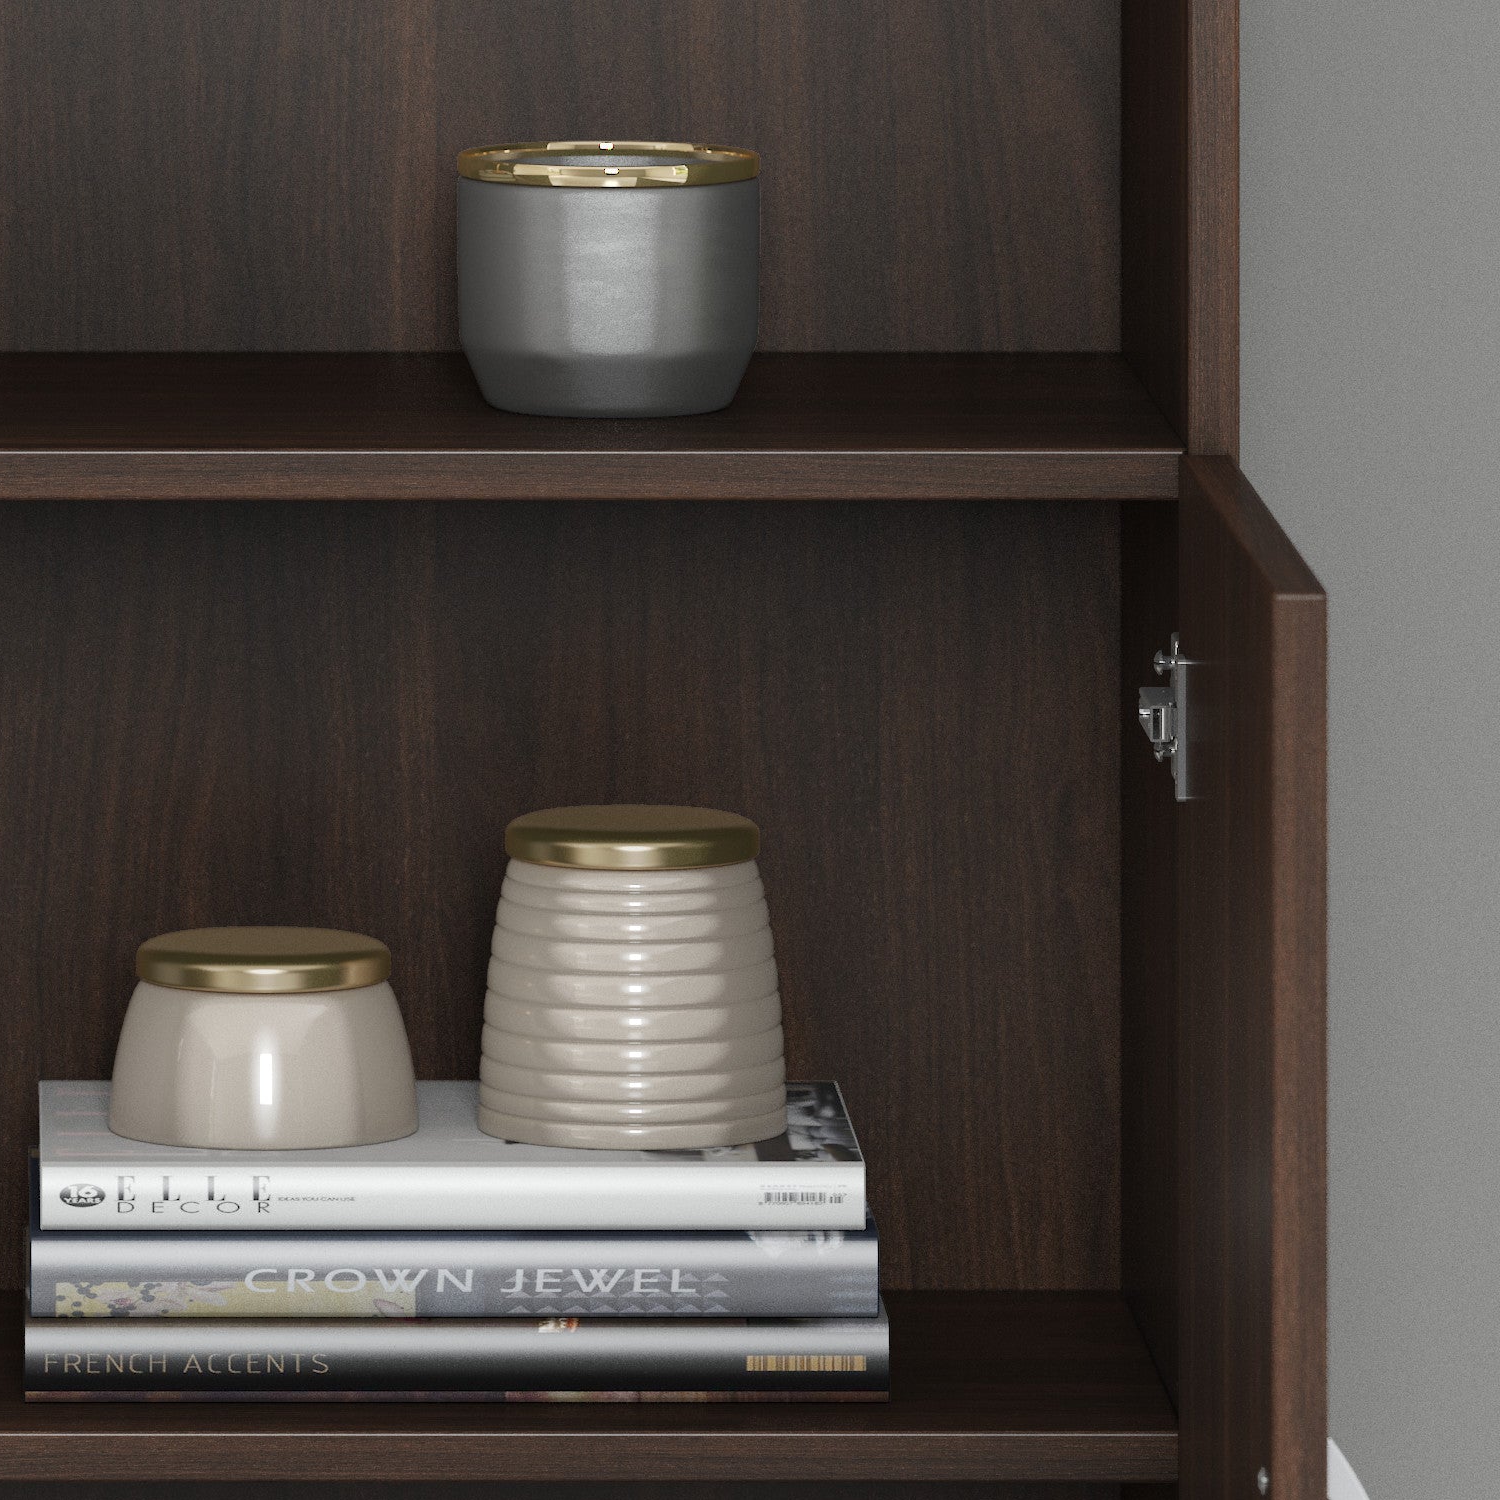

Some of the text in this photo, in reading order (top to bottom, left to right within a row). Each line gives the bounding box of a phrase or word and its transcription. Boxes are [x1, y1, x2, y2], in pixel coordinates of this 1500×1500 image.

[116, 1175, 271, 1201] ELLE
[116, 1201, 271, 1214] DECOR
[244, 1268, 697, 1294] CROWN JEWEL
[43, 1353, 330, 1375] FRENCH ACCENTS
